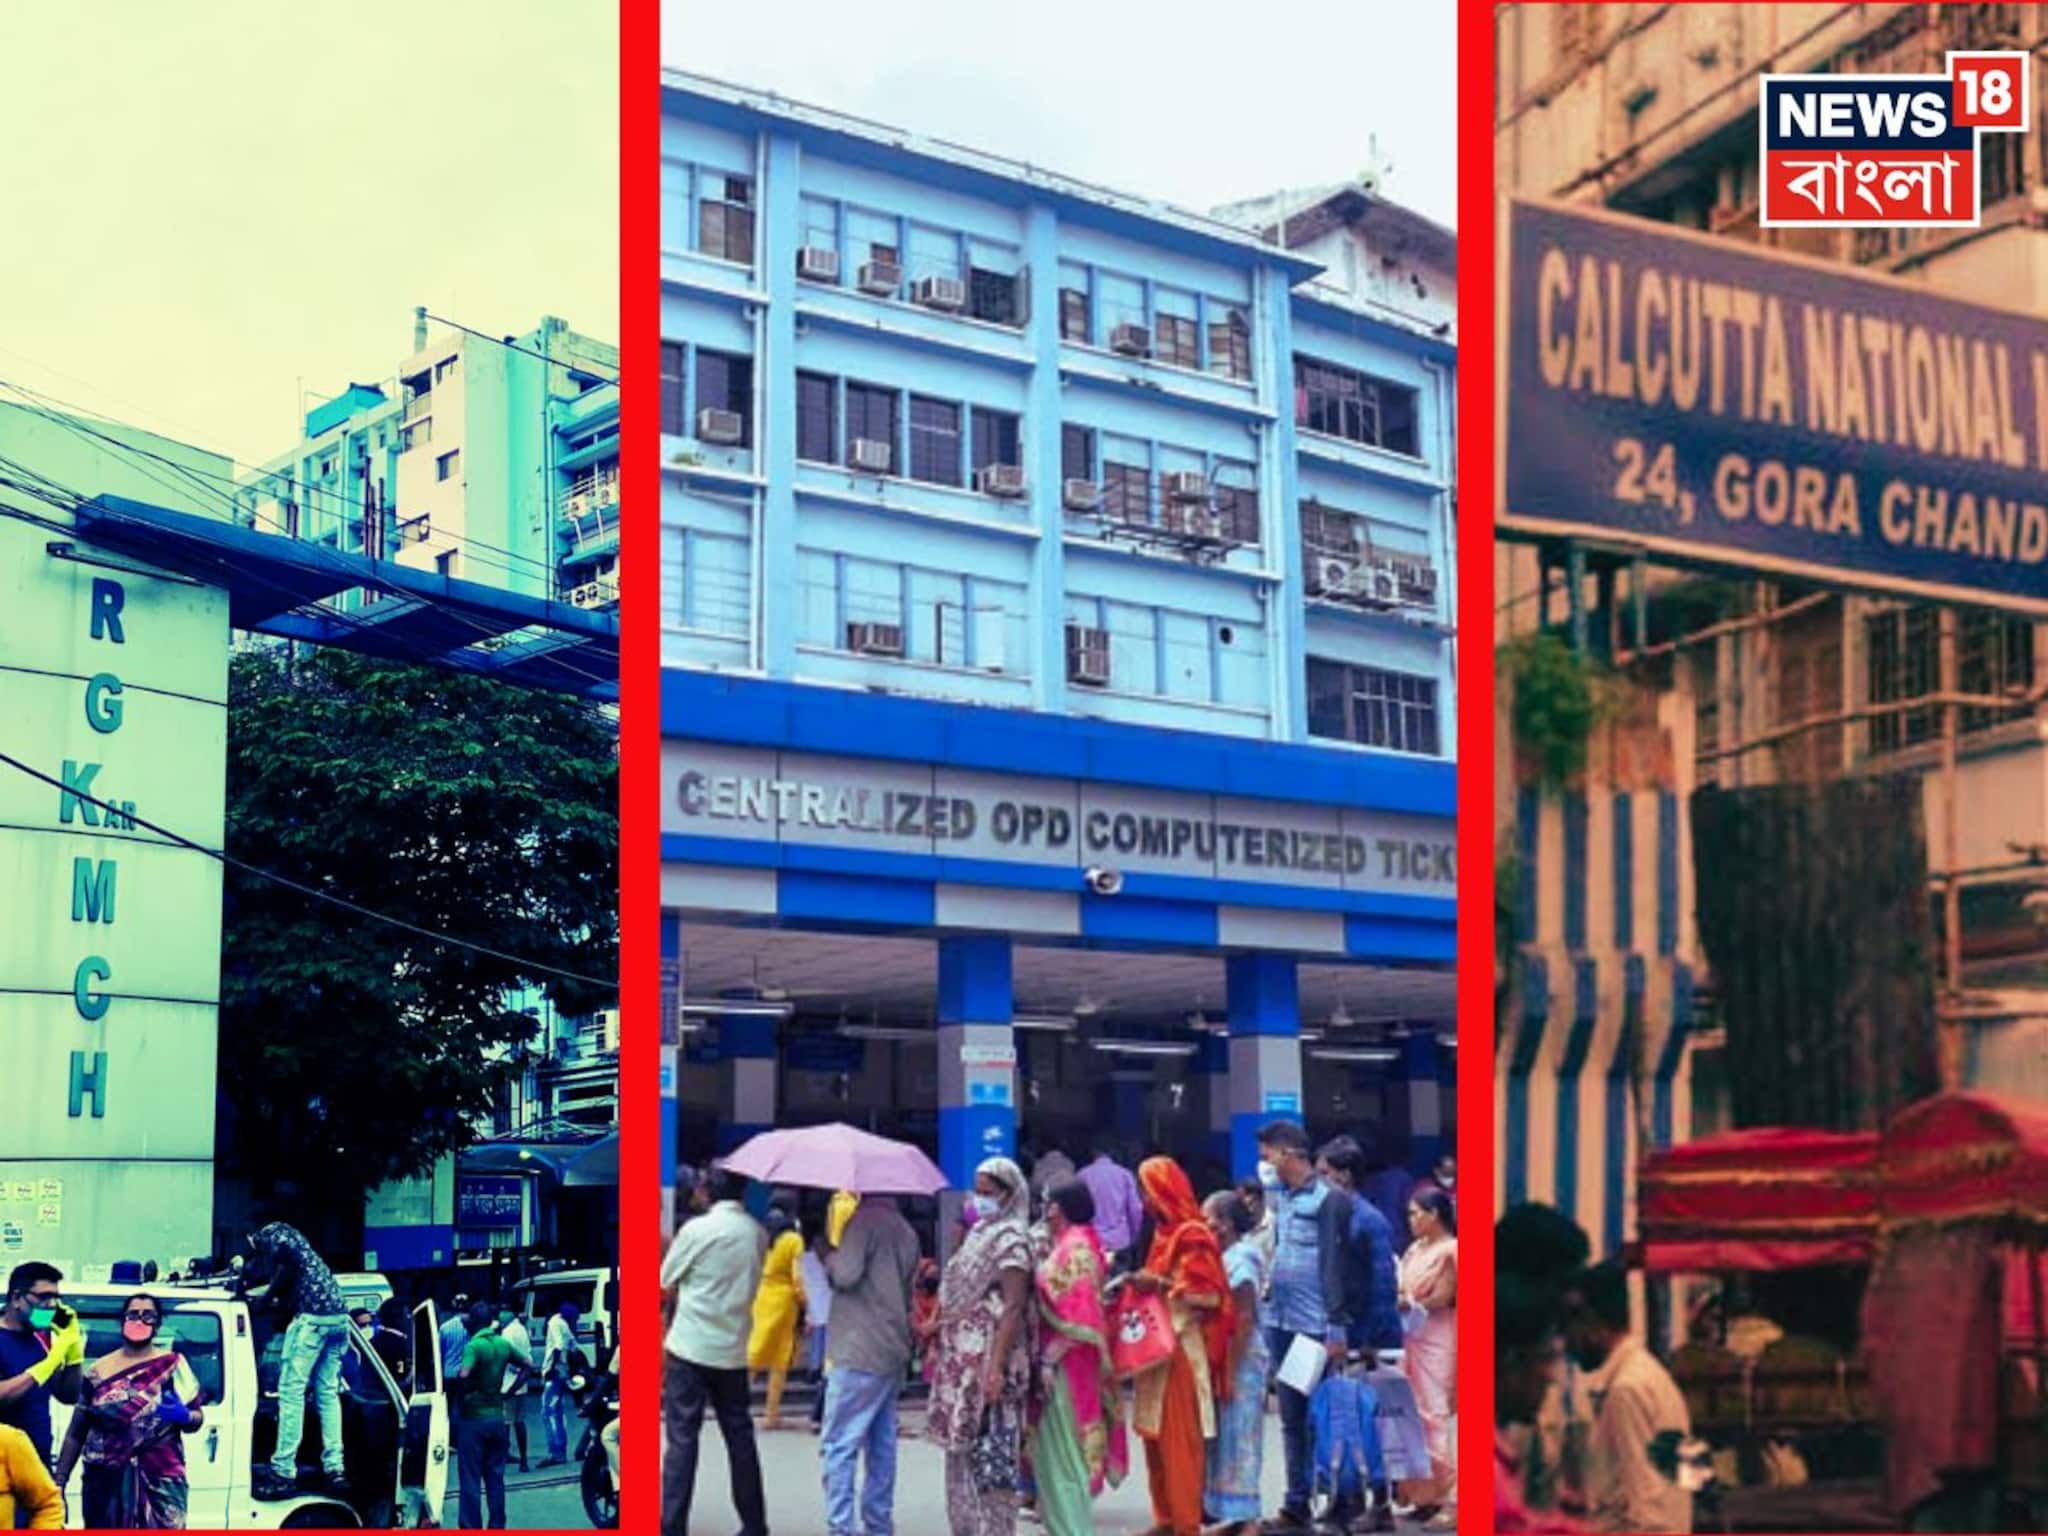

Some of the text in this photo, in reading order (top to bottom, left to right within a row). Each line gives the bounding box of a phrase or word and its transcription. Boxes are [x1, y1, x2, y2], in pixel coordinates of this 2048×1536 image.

[1538, 247, 1793, 426] CALCUTTA
[1806, 303, 2026, 468] NATIONAL
[1613, 438, 2047, 561] 24, GORA CHAND
[678, 771, 1456, 884] CENTRALIZED OPD COMPUTERIZED TICK
